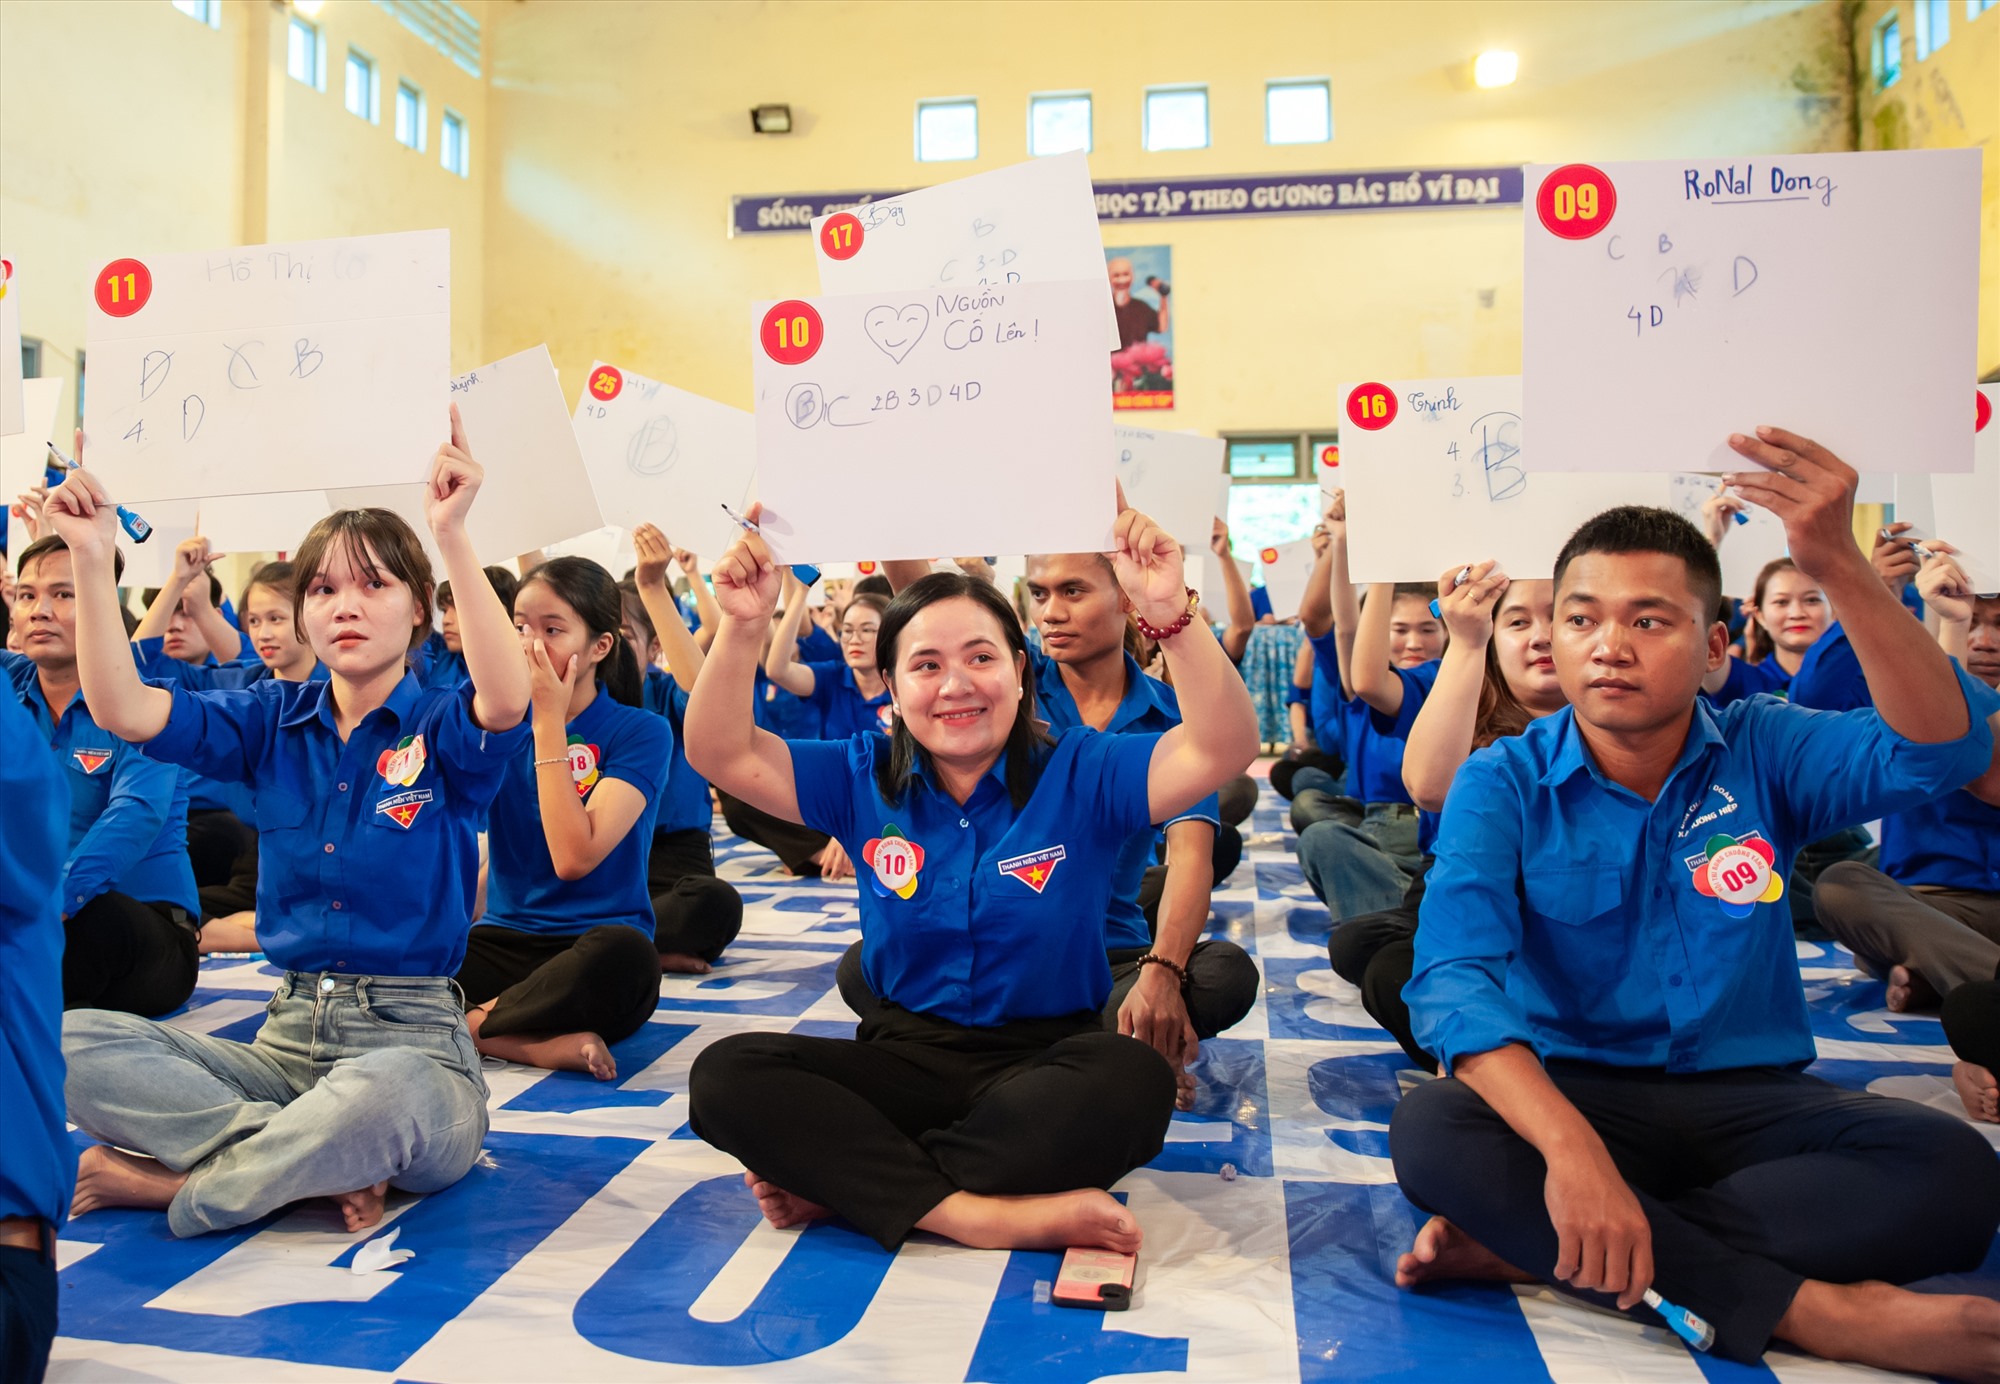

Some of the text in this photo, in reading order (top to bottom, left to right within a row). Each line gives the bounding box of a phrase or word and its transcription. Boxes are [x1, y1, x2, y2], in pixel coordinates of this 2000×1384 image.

[1141, 185, 1186, 216] TẬP
[1188, 187, 1249, 211] THEO
[1251, 182, 1334, 208] GƯƠNG
[1337, 176, 1385, 205] BÁC
[1387, 170, 1423, 203] HỒ
[1425, 173, 1454, 201] VĨ
[1455, 176, 1500, 204] ĐẠI
[1554, 183, 1599, 221] 09
[829, 223, 853, 250] 17
[107, 272, 137, 304] 11
[774, 316, 810, 349] 10
[593, 372, 618, 395] 25
[1357, 393, 1388, 419] 16
[883, 854, 907, 876] 10
[1002, 849, 1063, 871] THANH NIÊN VIỆT NAM
[1721, 861, 1758, 893] 09
